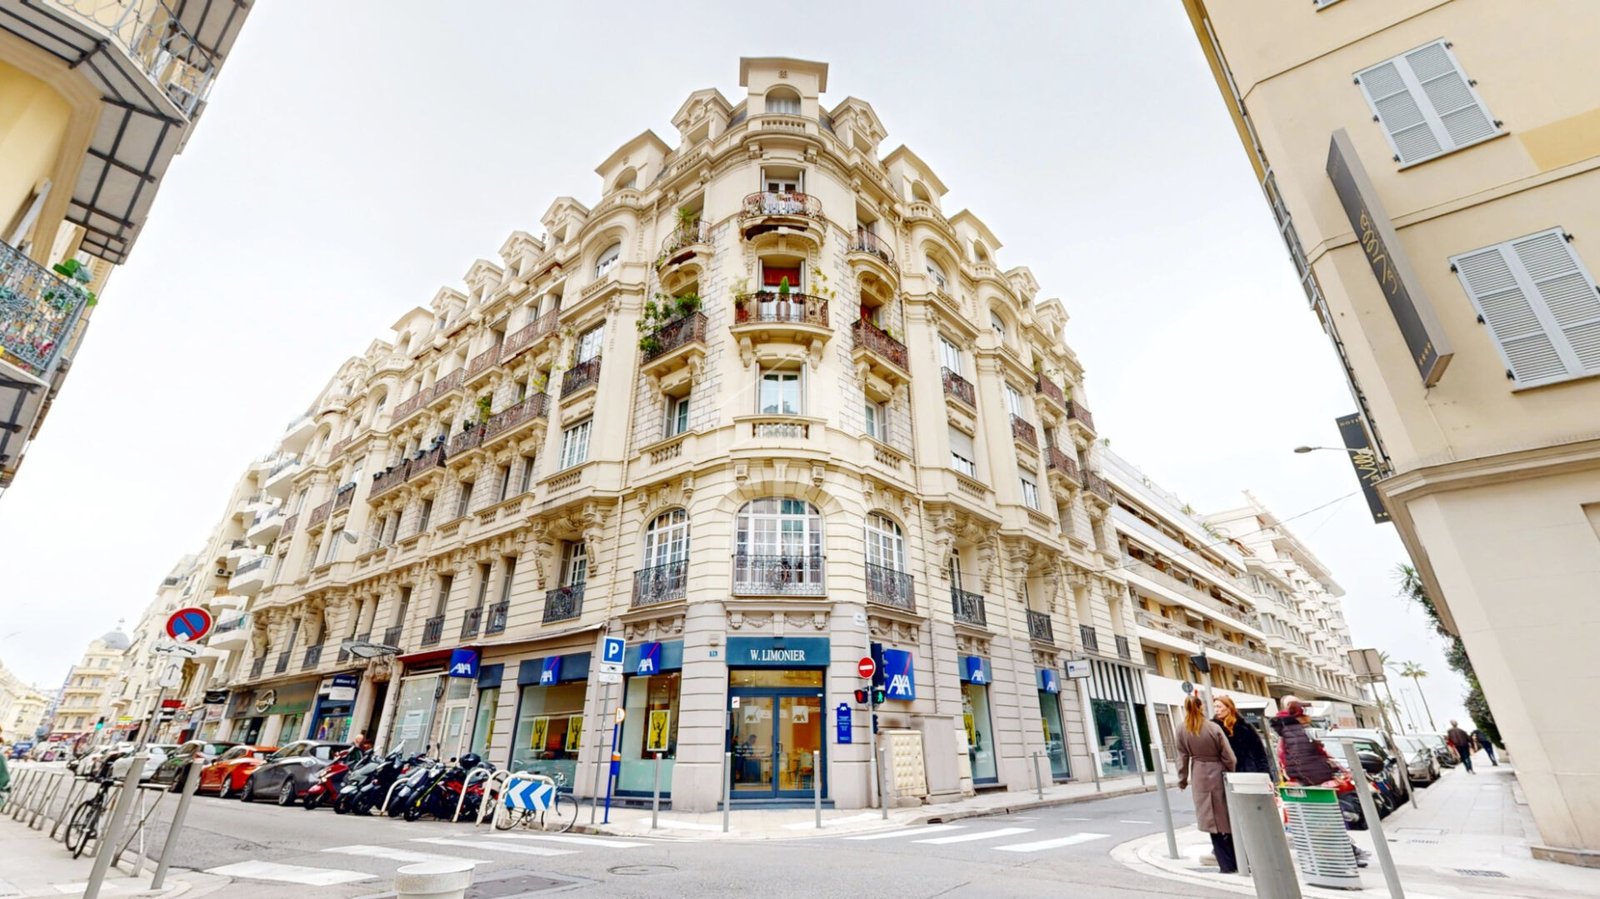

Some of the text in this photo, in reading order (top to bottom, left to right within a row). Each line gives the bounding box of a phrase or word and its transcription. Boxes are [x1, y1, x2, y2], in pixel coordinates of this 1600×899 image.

[1339, 418, 1360, 427] HOTE
[1353, 446, 1378, 480] Vill
[608, 642, 620, 658] P
[750, 649, 806, 662] W. LIMONIER
[450, 663, 471, 675] AXA
[638, 658, 653, 672] AXA
[540, 669, 553, 682] AXA
[971, 669, 985, 682] AXA
[887, 674, 912, 696] AXA
